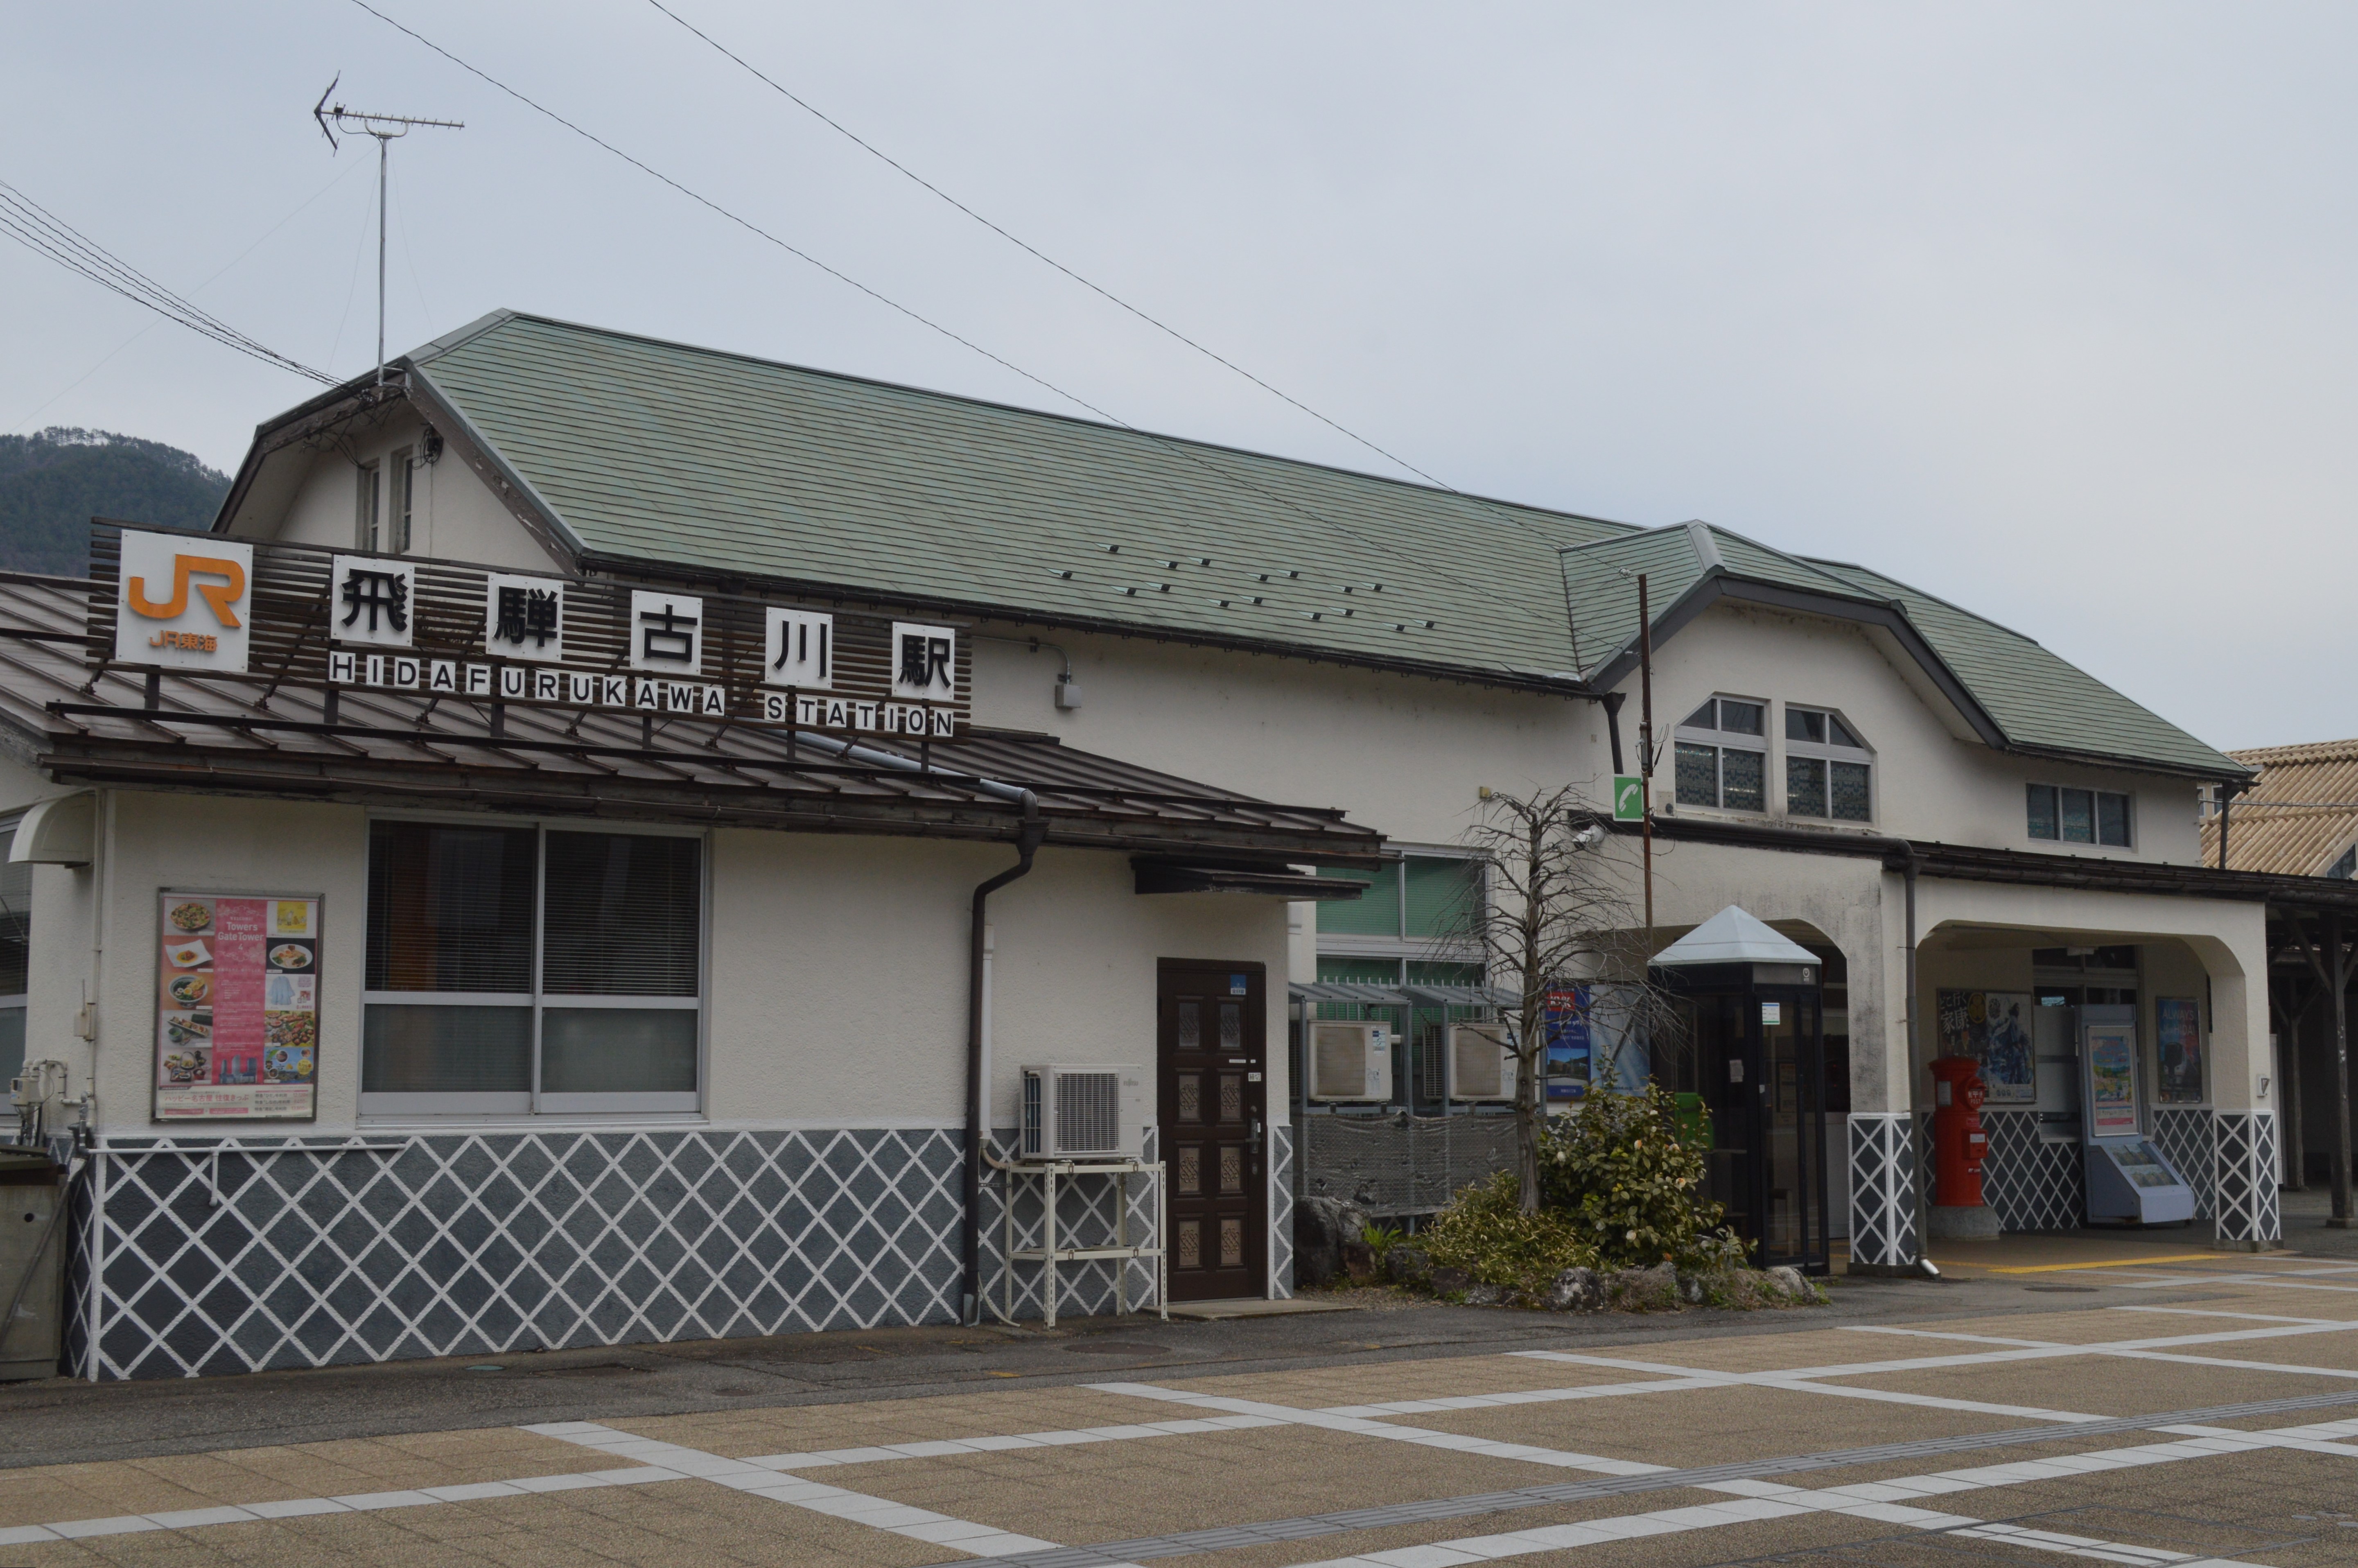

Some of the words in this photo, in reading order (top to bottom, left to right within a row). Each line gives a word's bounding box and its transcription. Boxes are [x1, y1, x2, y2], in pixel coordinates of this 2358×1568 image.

[128, 554, 245, 628] JR
[341, 568, 951, 689] 飛騨古川駅
[149, 630, 217, 653] JR東海
[332, 654, 723, 713] HIDAFURUKAWA
[768, 696, 951, 734] STATION
[226, 922, 258, 931] Towers
[218, 932, 237, 940] Gate
[238, 932, 264, 941] Tower
[1941, 1005, 1970, 1034] 家康
[2162, 1008, 2194, 1021] ALWAYS
[1123, 1079, 1138, 1087] FUJITSU
[165, 1094, 213, 1103] ハッピー名古屋
